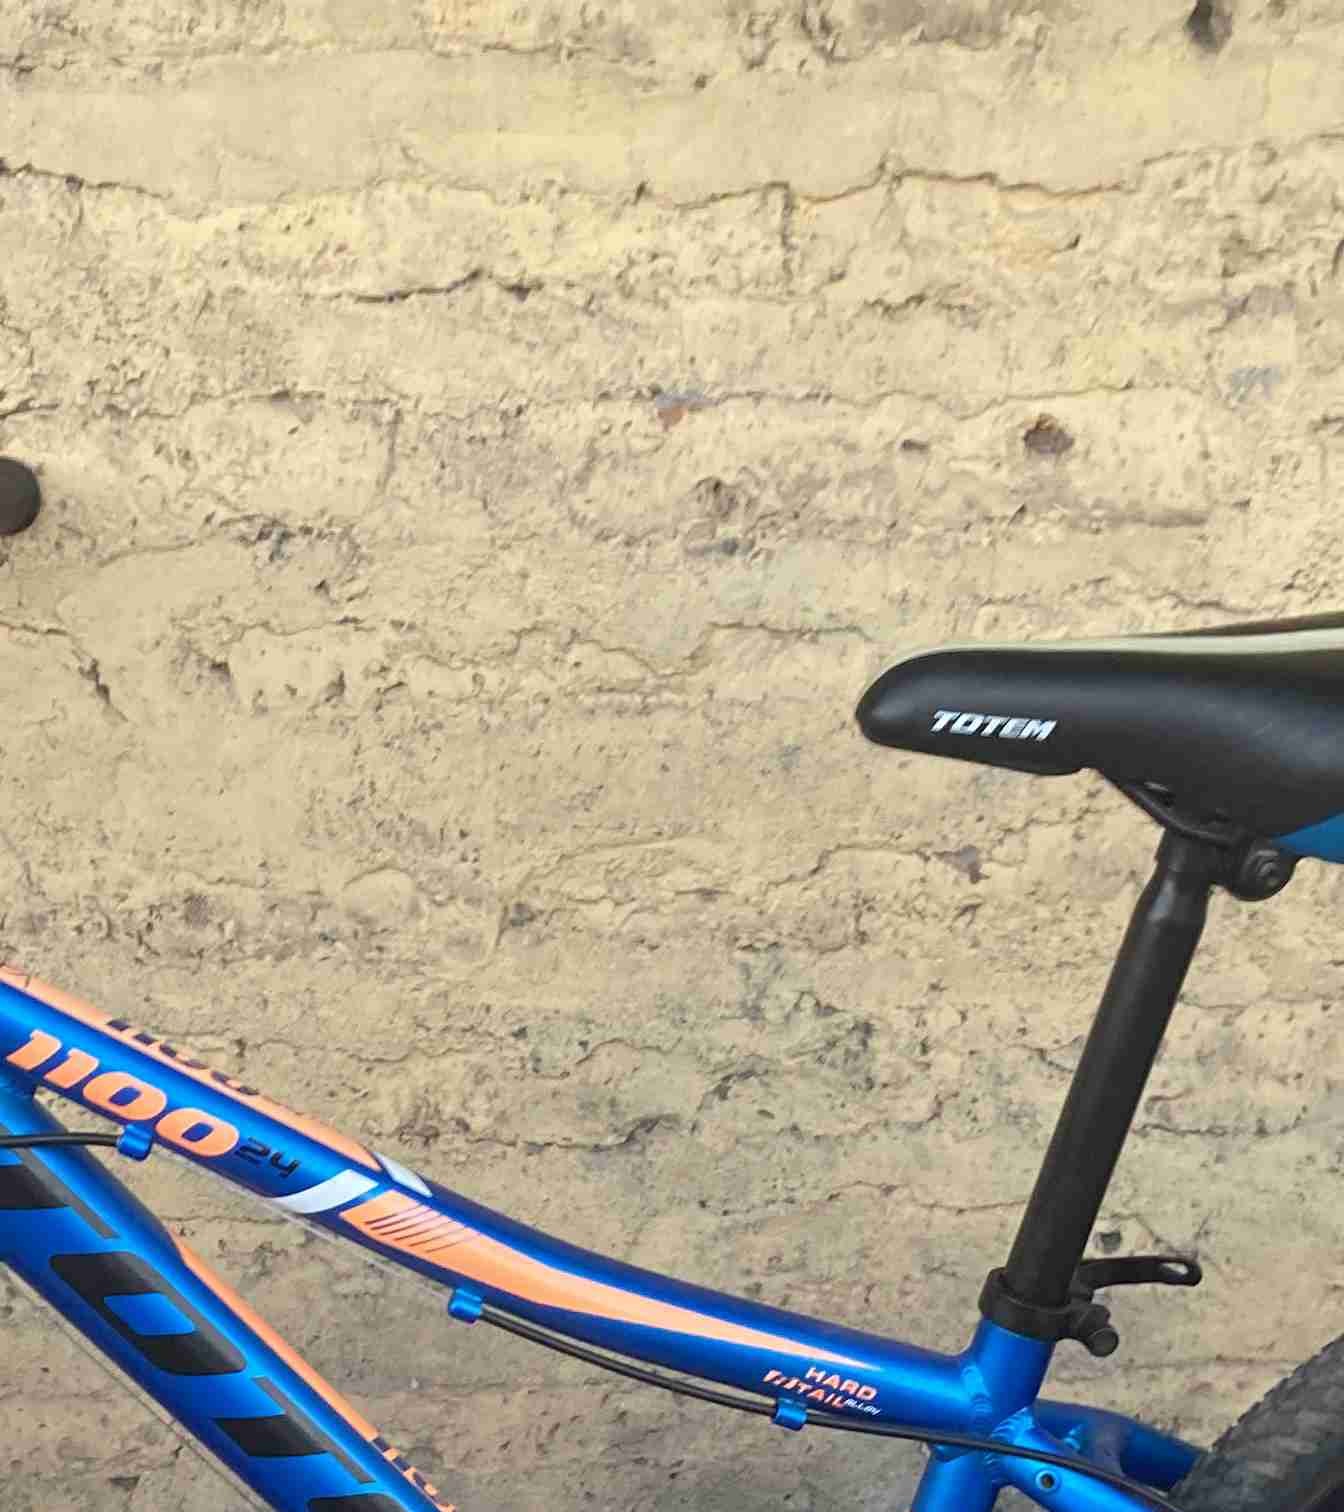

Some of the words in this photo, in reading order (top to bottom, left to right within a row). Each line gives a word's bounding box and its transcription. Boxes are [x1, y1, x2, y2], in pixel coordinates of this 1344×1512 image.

[930, 710, 1057, 742] TOTEM
[6, 1028, 239, 1157] 1100
[805, 1367, 877, 1400] HARD
